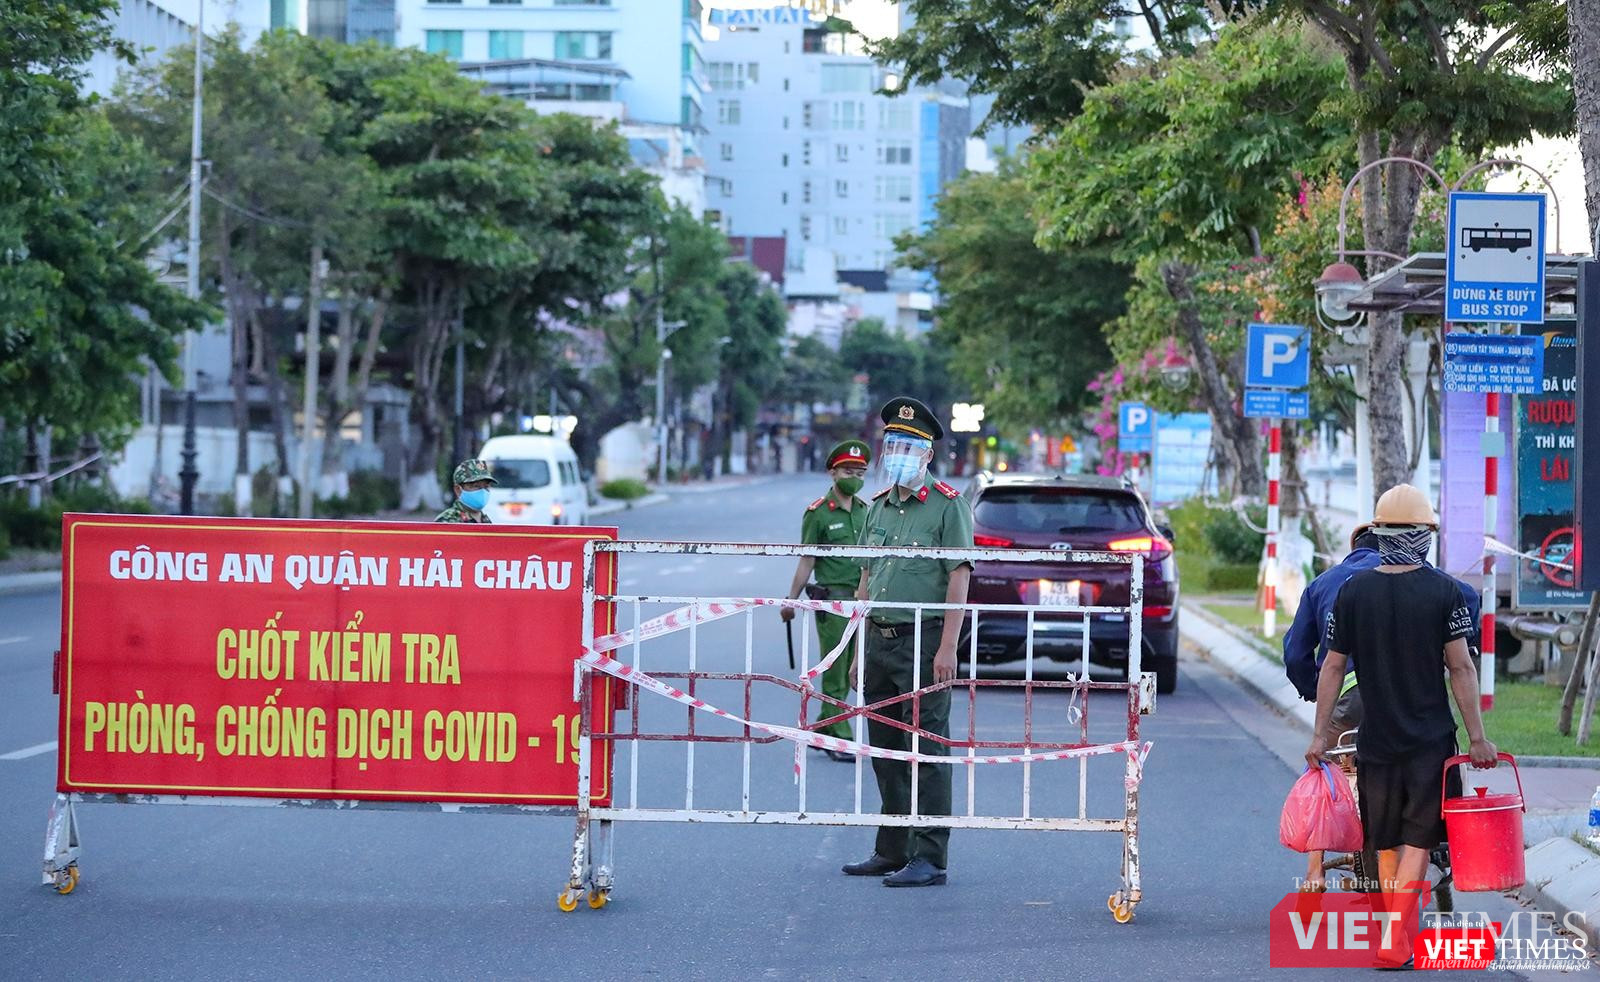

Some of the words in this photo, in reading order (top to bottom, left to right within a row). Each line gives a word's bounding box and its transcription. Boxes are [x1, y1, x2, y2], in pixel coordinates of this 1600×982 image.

[1453, 284, 1486, 301] DỪNG
[1489, 289, 1503, 301] XE
[1507, 287, 1536, 302] BUÝT
[1461, 304, 1489, 315] BUS
[1494, 304, 1528, 316] STOP
[1263, 334, 1298, 377] P
[1543, 376, 1559, 391] ĐÃ
[1128, 408, 1148, 432] P
[1535, 433, 1555, 448] THÌ
[1541, 453, 1569, 480] LÁI
[109, 544, 208, 582] CÔNG
[219, 553, 274, 583] AN
[285, 550, 389, 590] QUẬN
[399, 550, 463, 588] HẢI
[474, 554, 572, 591] CHÂU
[216, 611, 299, 681] CHỐT
[309, 610, 391, 683] KIỂM
[402, 633, 461, 685] TRA
[85, 690, 205, 762] PHÒNG,
[216, 688, 326, 758] CHỐNG
[337, 708, 412, 771] DỊCH
[424, 709, 517, 763] COVID
[528, 736, 540, 747] -
